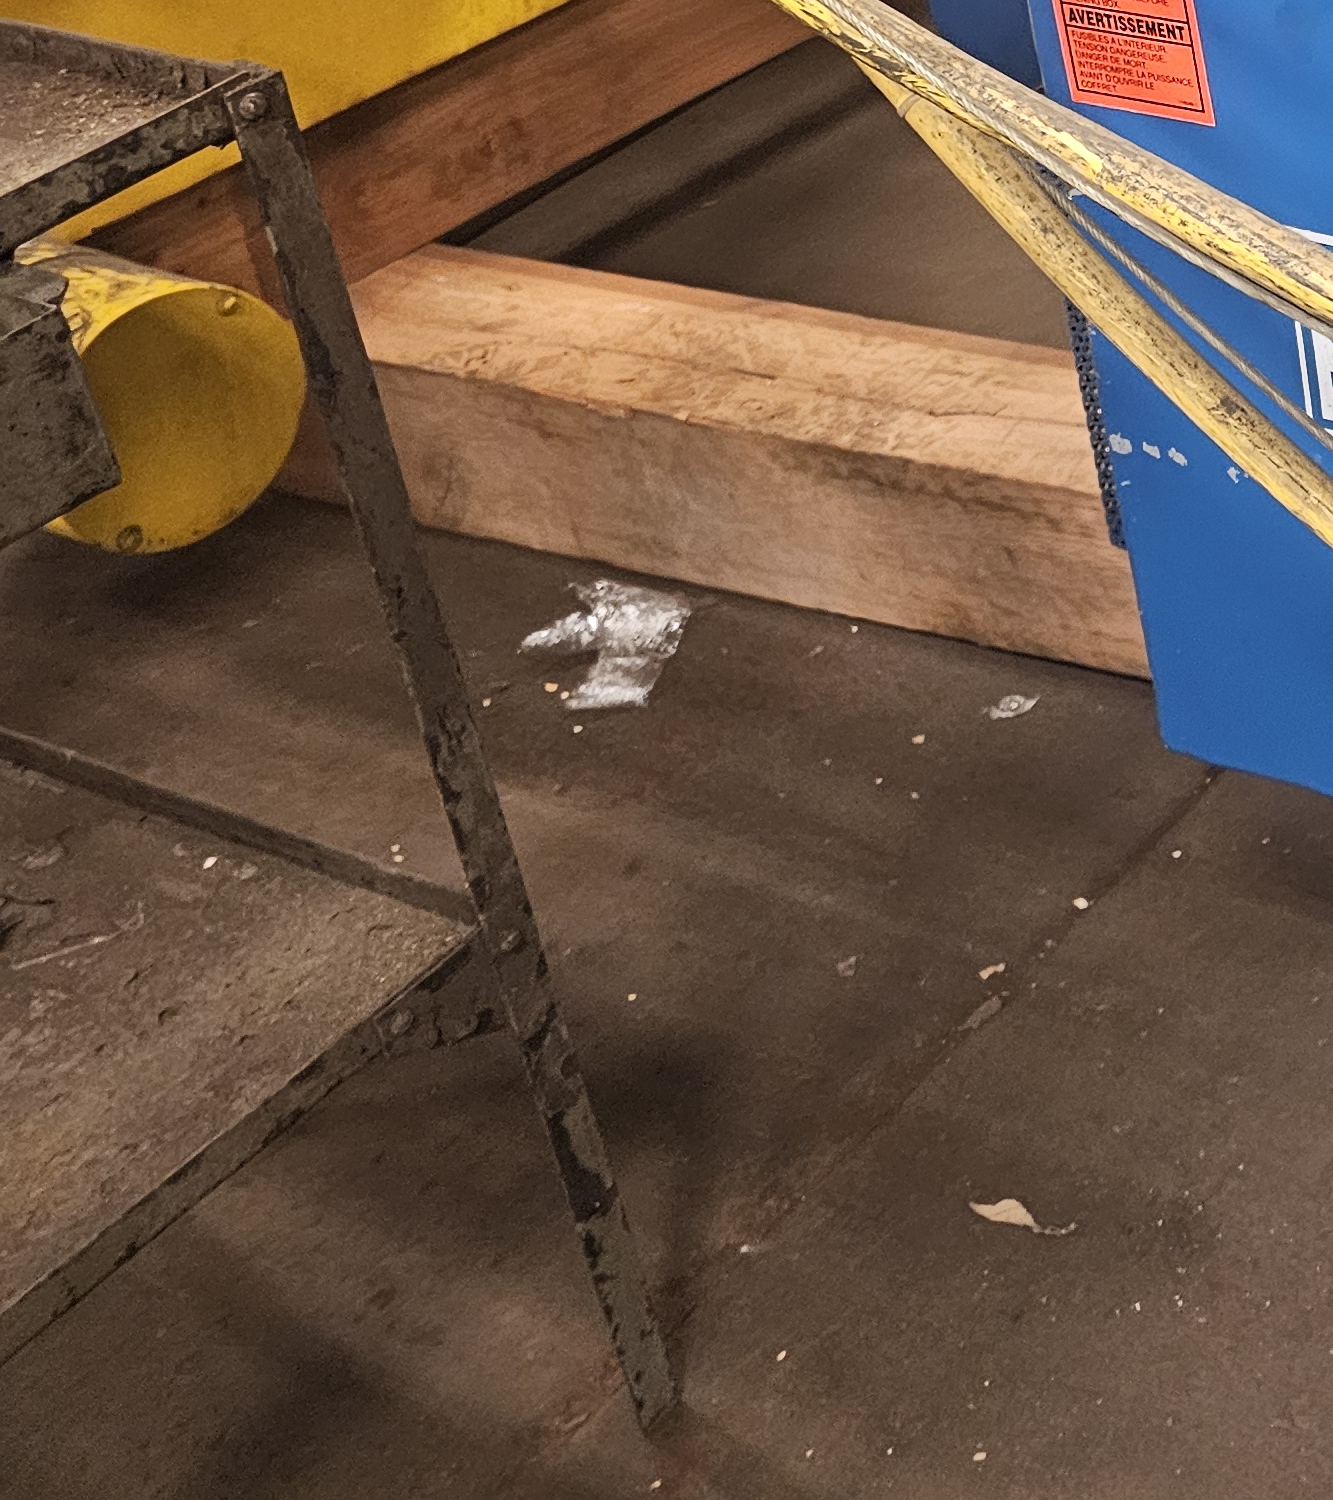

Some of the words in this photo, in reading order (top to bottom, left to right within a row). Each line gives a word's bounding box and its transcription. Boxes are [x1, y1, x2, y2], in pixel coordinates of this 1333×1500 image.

[1068, 8, 1184, 41] AVERTISSEMENT
[1072, 30, 1109, 43] FUSIBLES
[1073, 40, 1107, 52] TENSION
[1075, 50, 1108, 61] DANGER
[1110, 56, 1119, 64] DE
[1078, 61, 1135, 77] INTERROMPRE
[1136, 70, 1146, 78] LA
[1148, 73, 1193, 87] PUISSANCE
[1079, 70, 1103, 80] AVANT
[1145, 82, 1154, 90] LE
